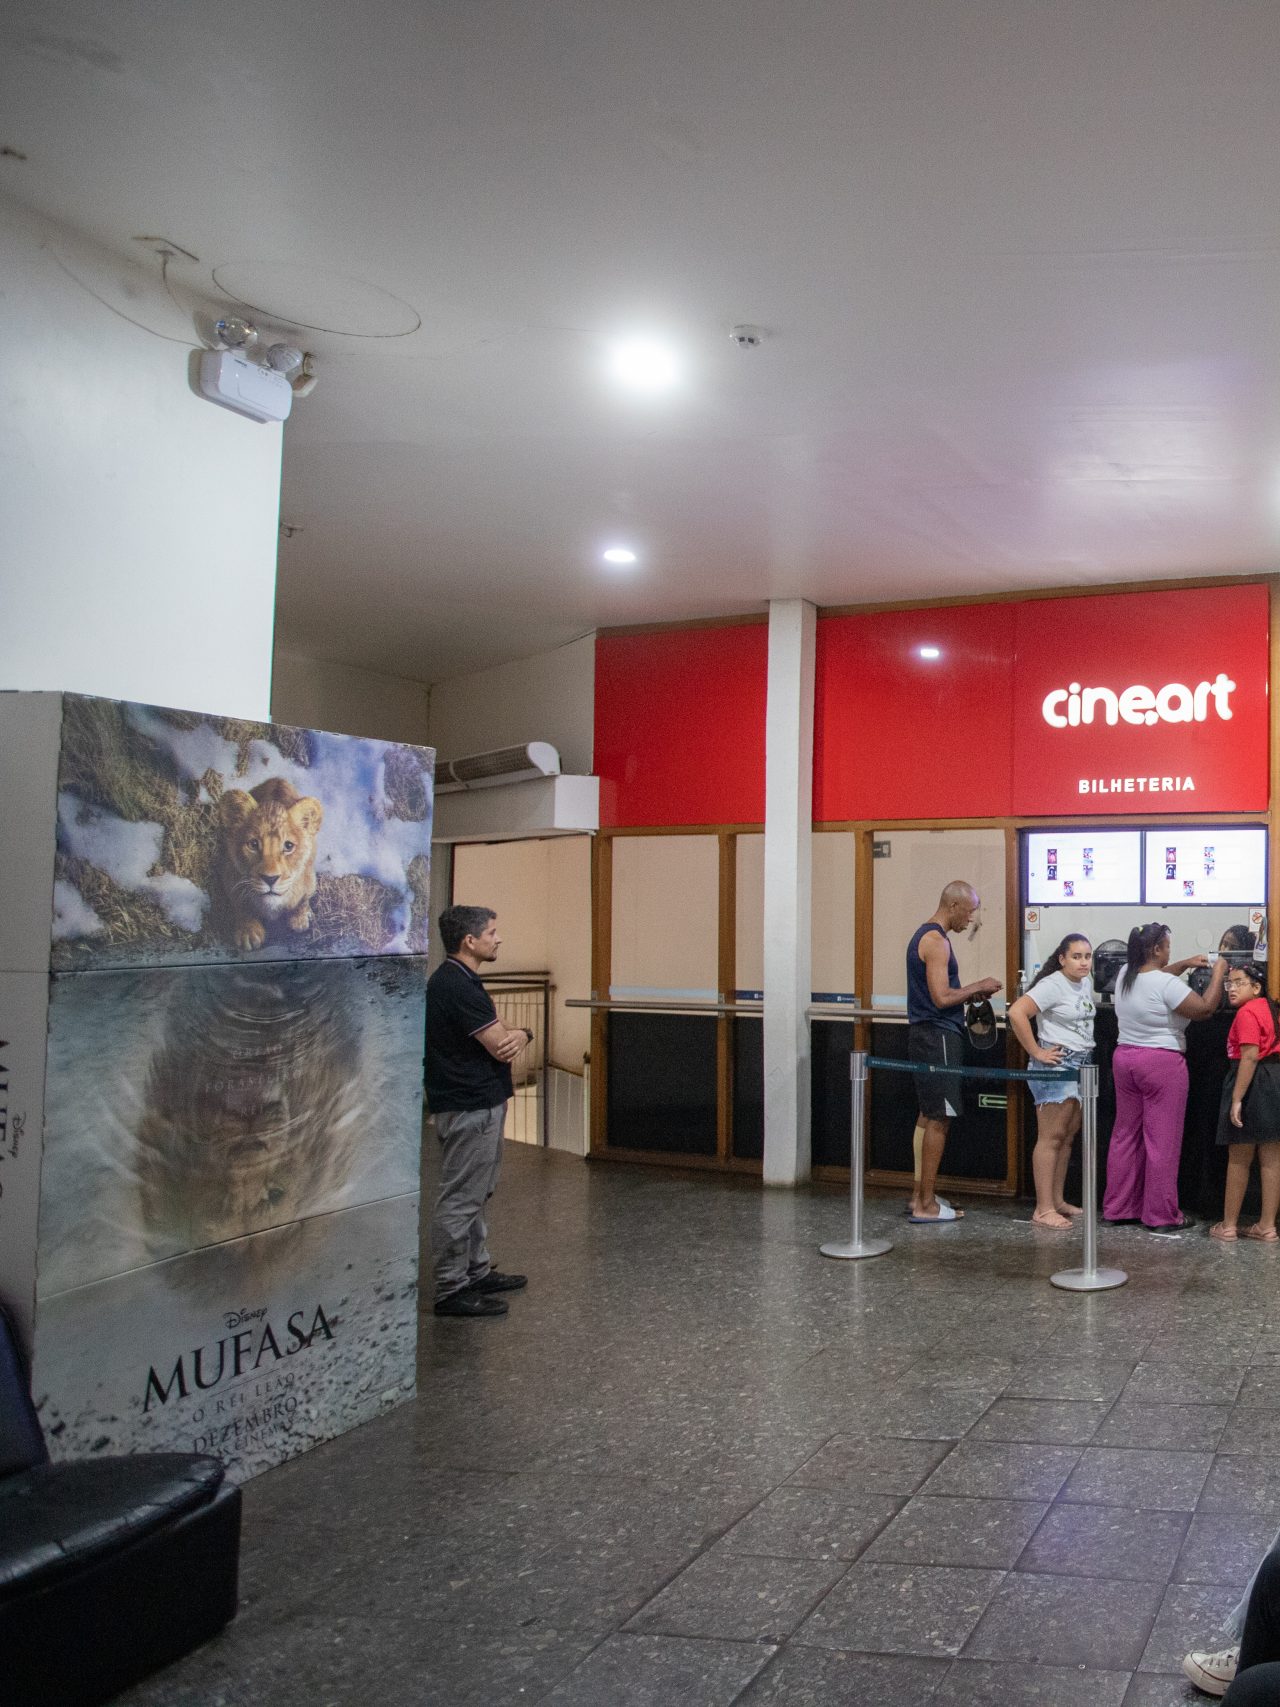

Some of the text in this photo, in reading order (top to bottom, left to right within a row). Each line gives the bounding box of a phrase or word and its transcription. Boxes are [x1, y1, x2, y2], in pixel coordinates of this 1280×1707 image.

[1078, 776, 1196, 793] BILHETERIA
[141, 1304, 336, 1414] MUFASA
[192, 1408, 205, 1422] O
[216, 1394, 244, 1413] REI
[193, 1396, 298, 1454] DEZEMBRO
